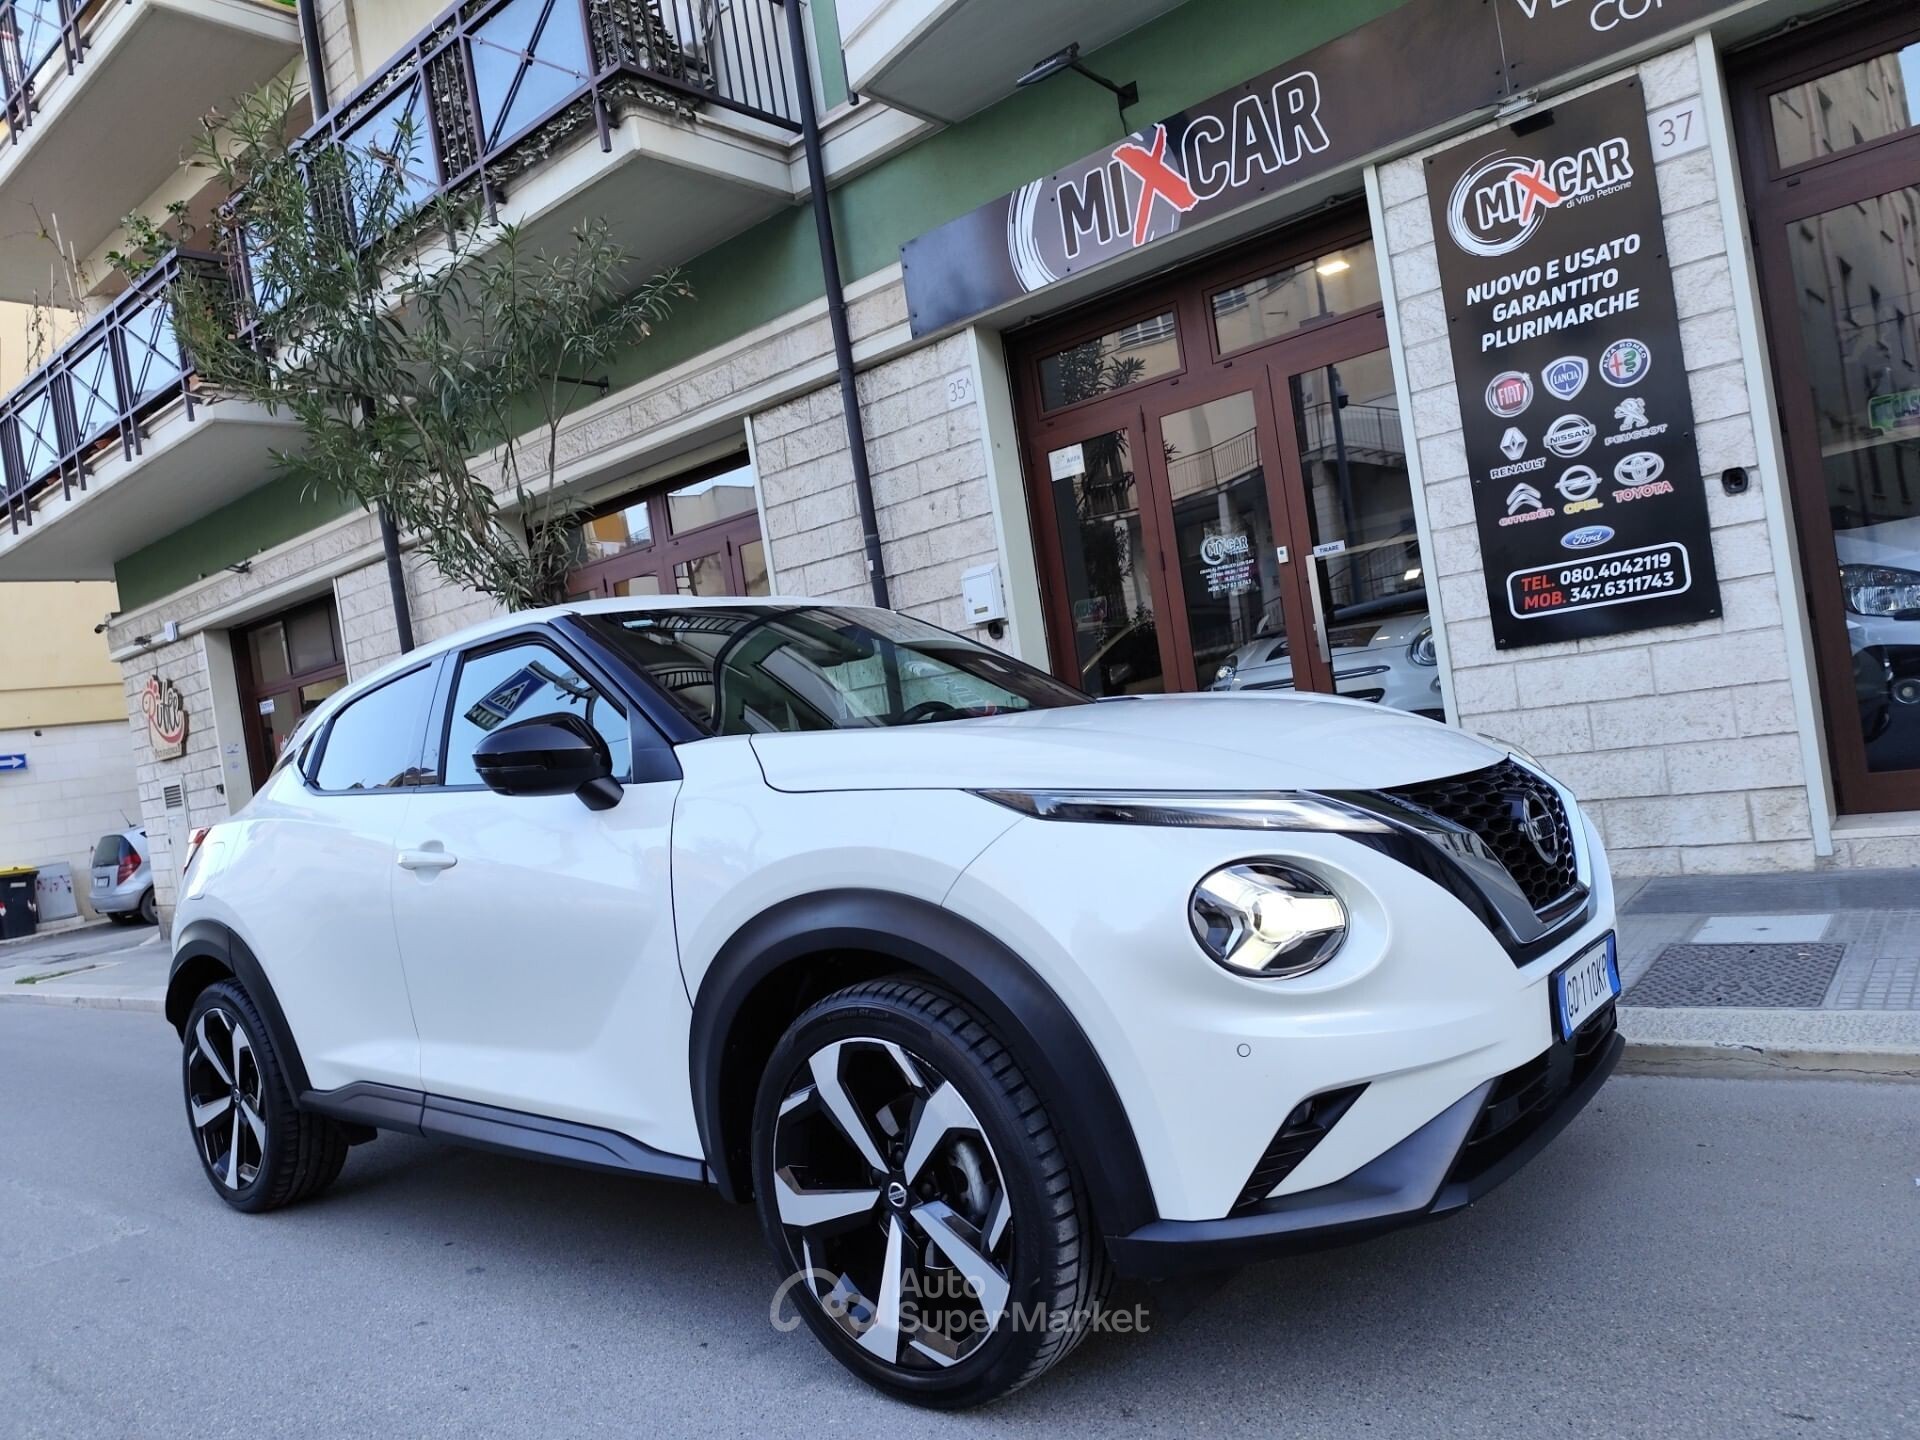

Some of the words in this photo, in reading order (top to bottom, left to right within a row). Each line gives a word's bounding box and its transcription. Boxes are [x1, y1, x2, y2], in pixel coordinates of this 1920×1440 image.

[1590, 0, 1663, 31] CO
[1657, 110, 1693, 147] 37
[1057, 71, 1330, 259] MIXCAR
[1475, 137, 1634, 230] MIXCAR
[1566, 199, 1575, 209] di
[1576, 194, 1595, 205] Vito
[1596, 181, 1632, 198] Petrone
[1466, 265, 1541, 306] NUOVO
[1546, 259, 1560, 281] E
[1564, 233, 1641, 274] USATO
[1492, 268, 1619, 323] GARANTITO
[1482, 288, 1640, 352] PLURIMARCHE
[1619, 341, 1647, 359] ROMEO
[1554, 370, 1579, 385] LANCIA
[1497, 383, 1521, 407] FIAT
[1550, 428, 1590, 444] NISSAN
[1604, 423, 1668, 446] PEUGEOT
[1490, 457, 1547, 479] RENAULT
[1612, 480, 1674, 503] TOYOTA
[1563, 498, 1604, 515] OPEL
[1572, 530, 1603, 546] Ford
[1521, 574, 1556, 592] TEL.
[1560, 552, 1671, 585] 080.4042119
[1524, 591, 1566, 610] MOB.
[1570, 571, 1674, 602] 347.6311743
